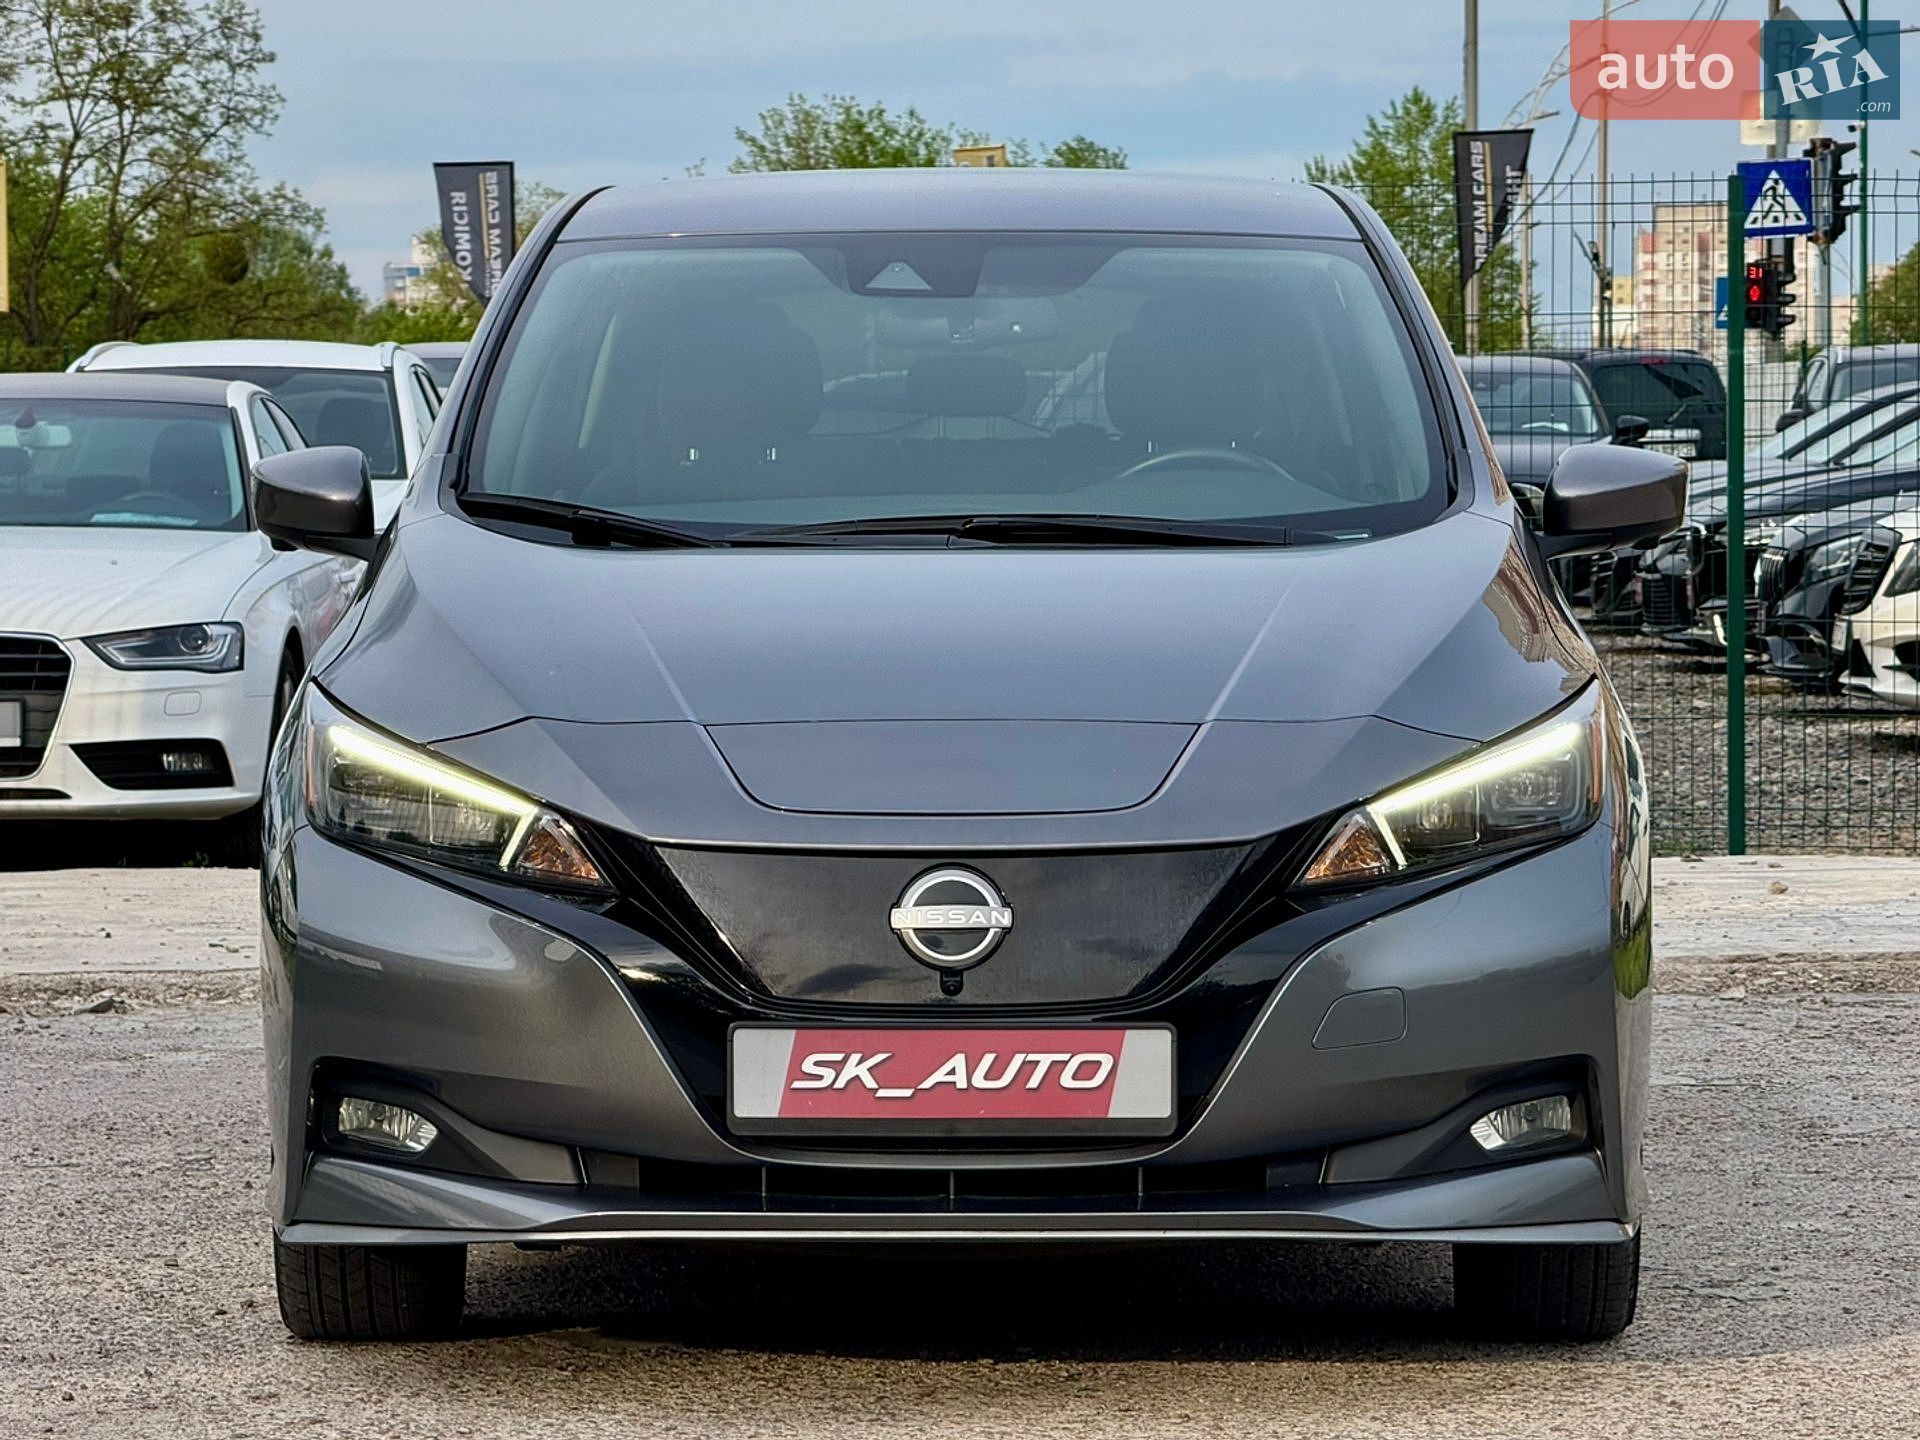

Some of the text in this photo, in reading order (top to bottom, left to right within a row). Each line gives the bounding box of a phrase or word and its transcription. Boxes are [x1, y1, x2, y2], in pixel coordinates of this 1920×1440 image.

[1470, 141, 1486, 196] CARS
[893, 909, 1010, 926] NISSAN
[790, 1052, 1116, 1099] SK_AUTO
